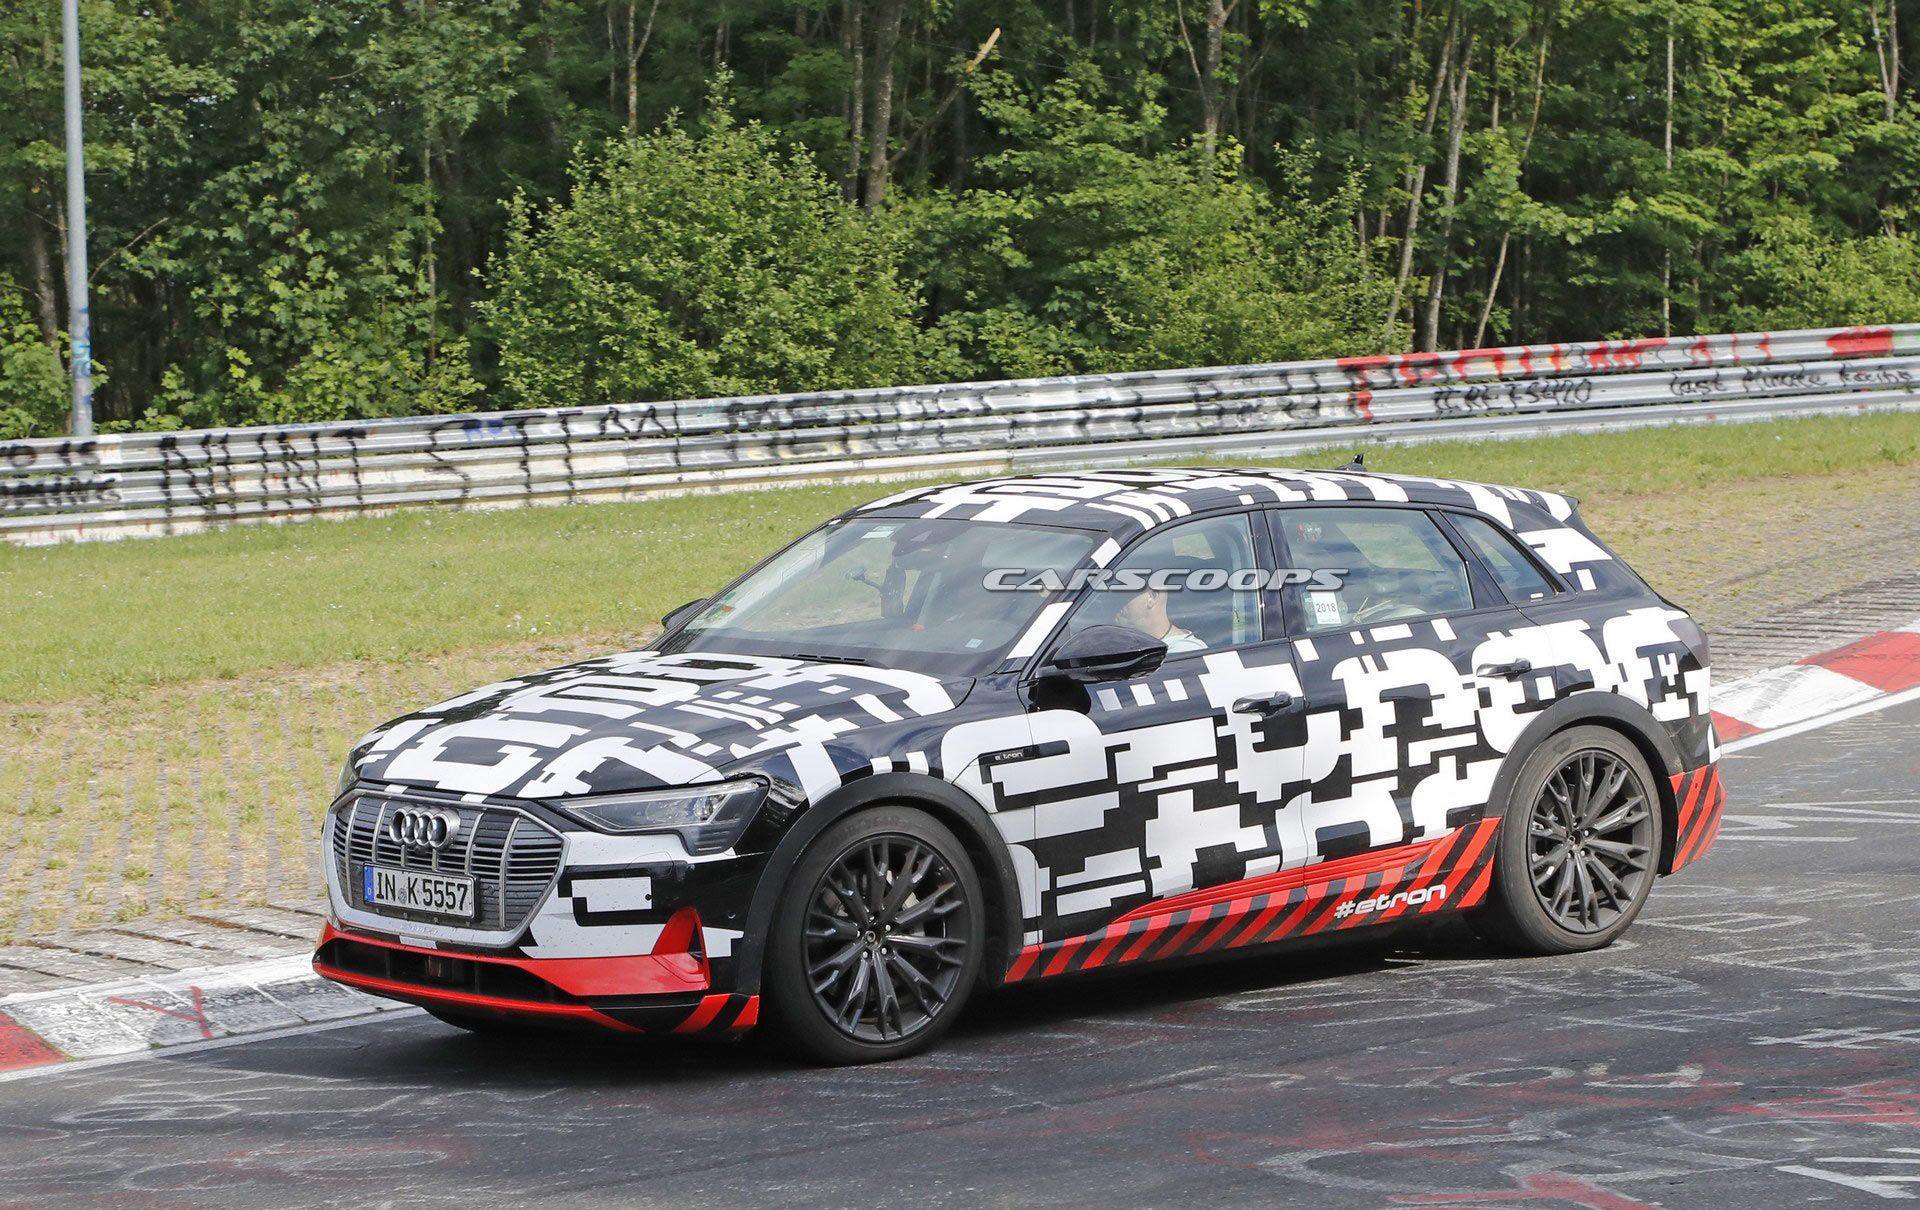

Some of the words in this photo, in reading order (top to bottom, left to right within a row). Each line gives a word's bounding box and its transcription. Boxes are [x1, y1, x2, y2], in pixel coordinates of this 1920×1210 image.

[1315, 602, 1337, 613] 2018
[376, 872, 396, 901] IN
[422, 879, 468, 911] 5557
[1333, 884, 1447, 919] #etron
